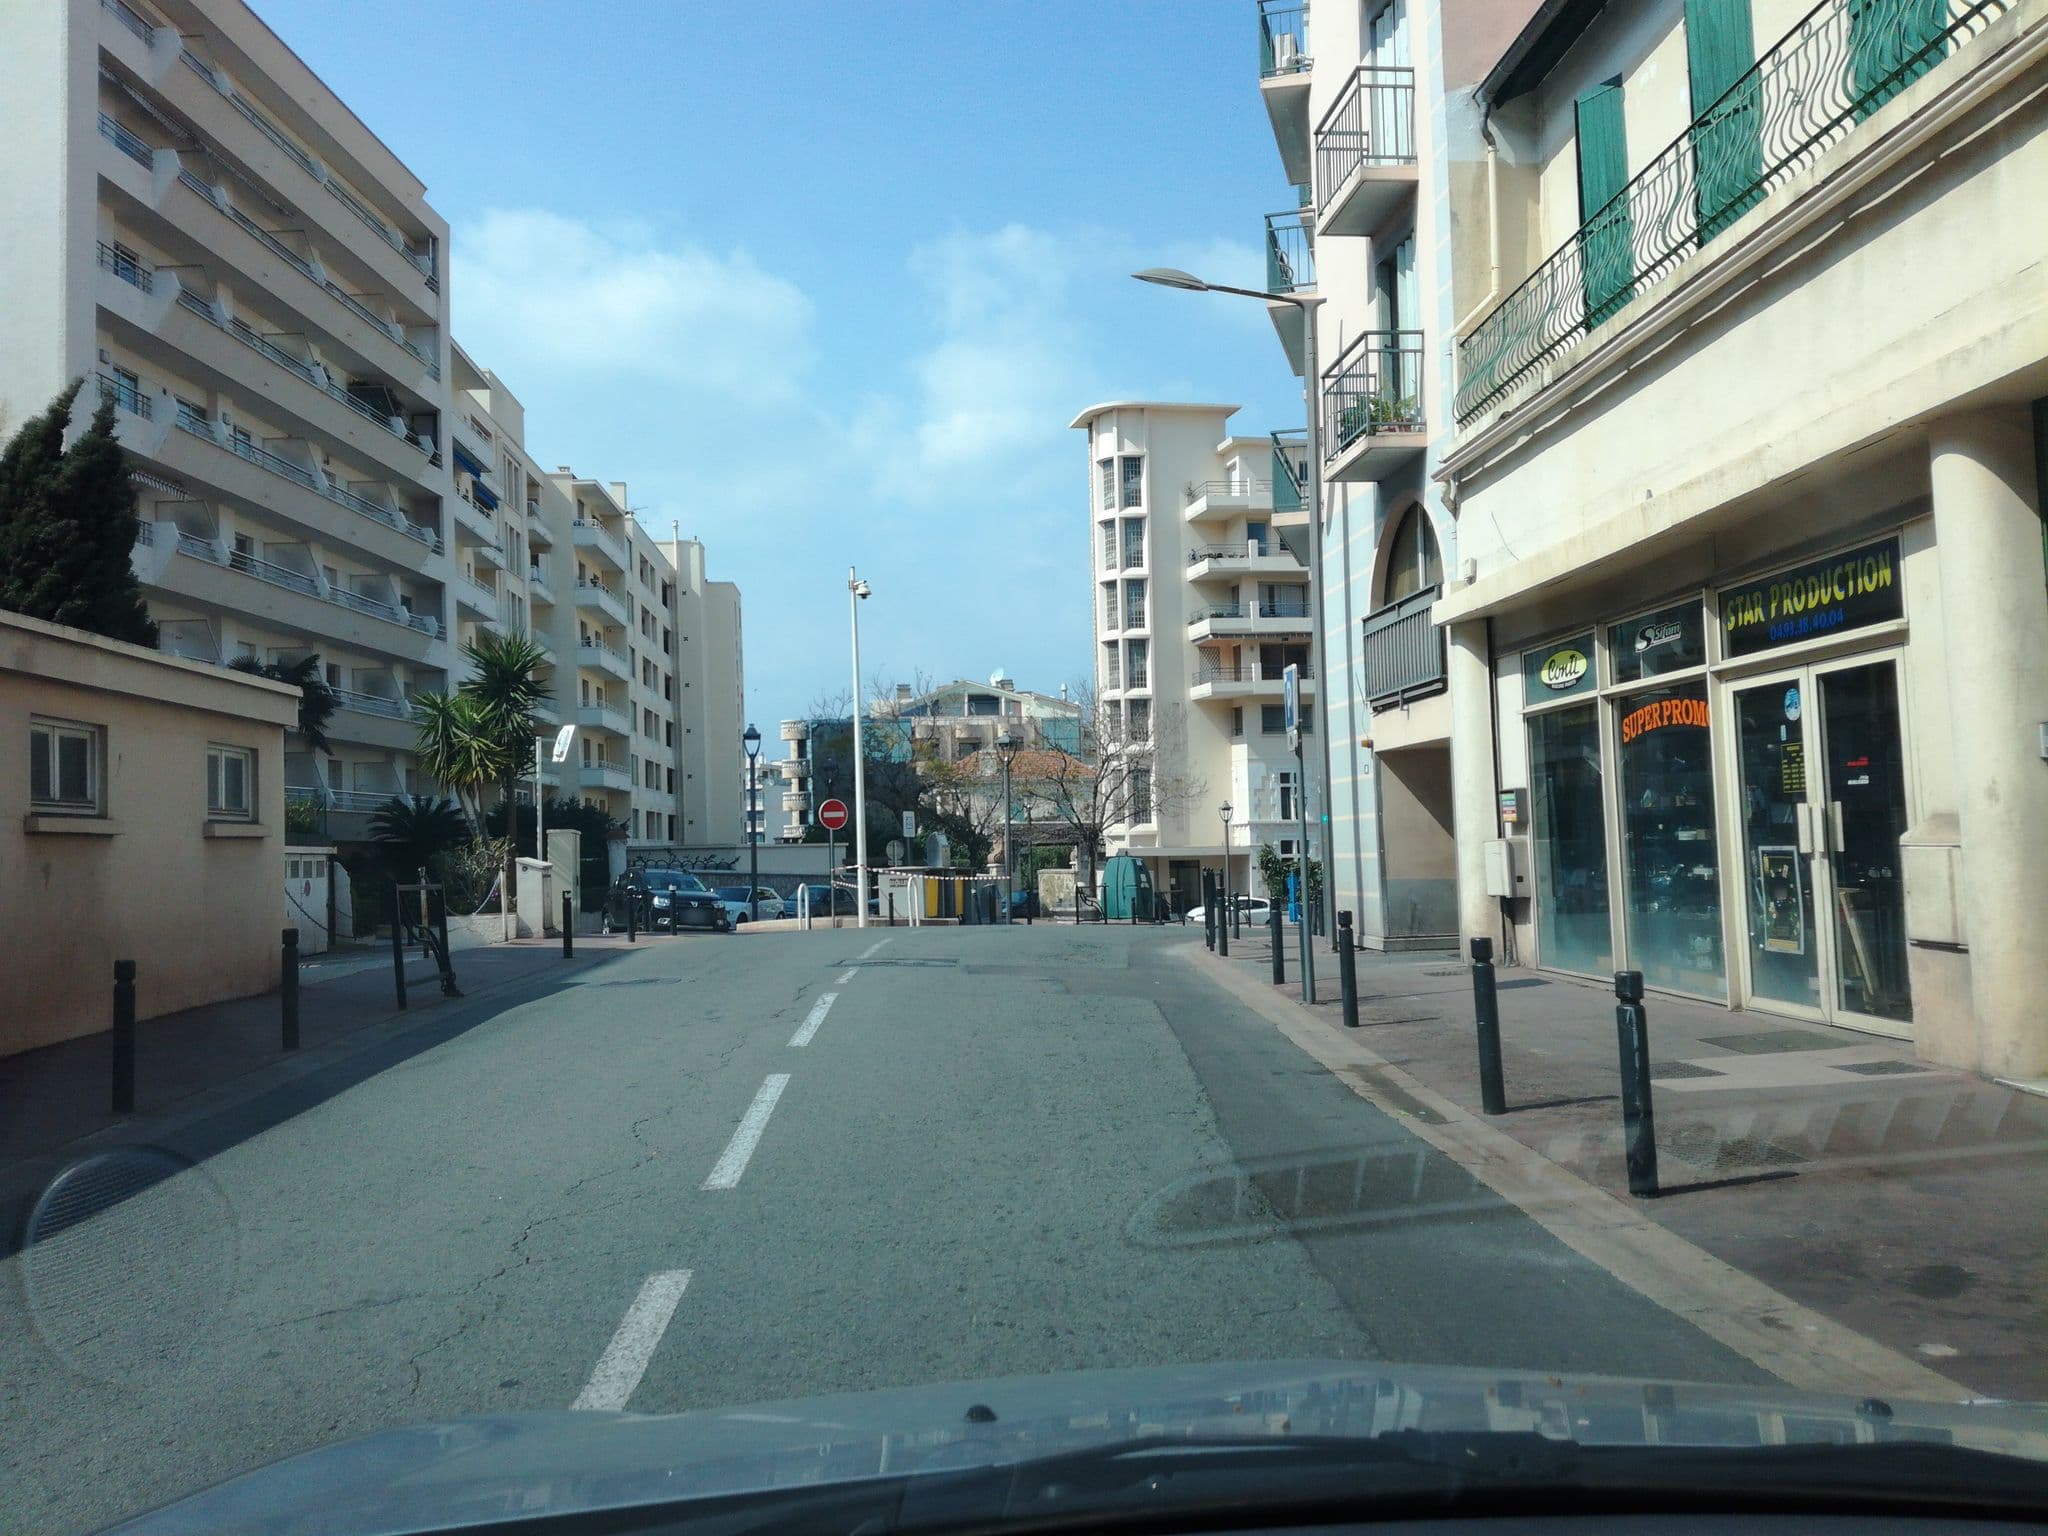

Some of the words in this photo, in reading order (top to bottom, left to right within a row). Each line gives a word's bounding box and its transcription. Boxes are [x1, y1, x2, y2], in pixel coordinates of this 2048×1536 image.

[1727, 590, 1765, 631] STAR
[1769, 550, 1892, 619] PRODUCTION
[1622, 702, 1661, 743] SUPER
